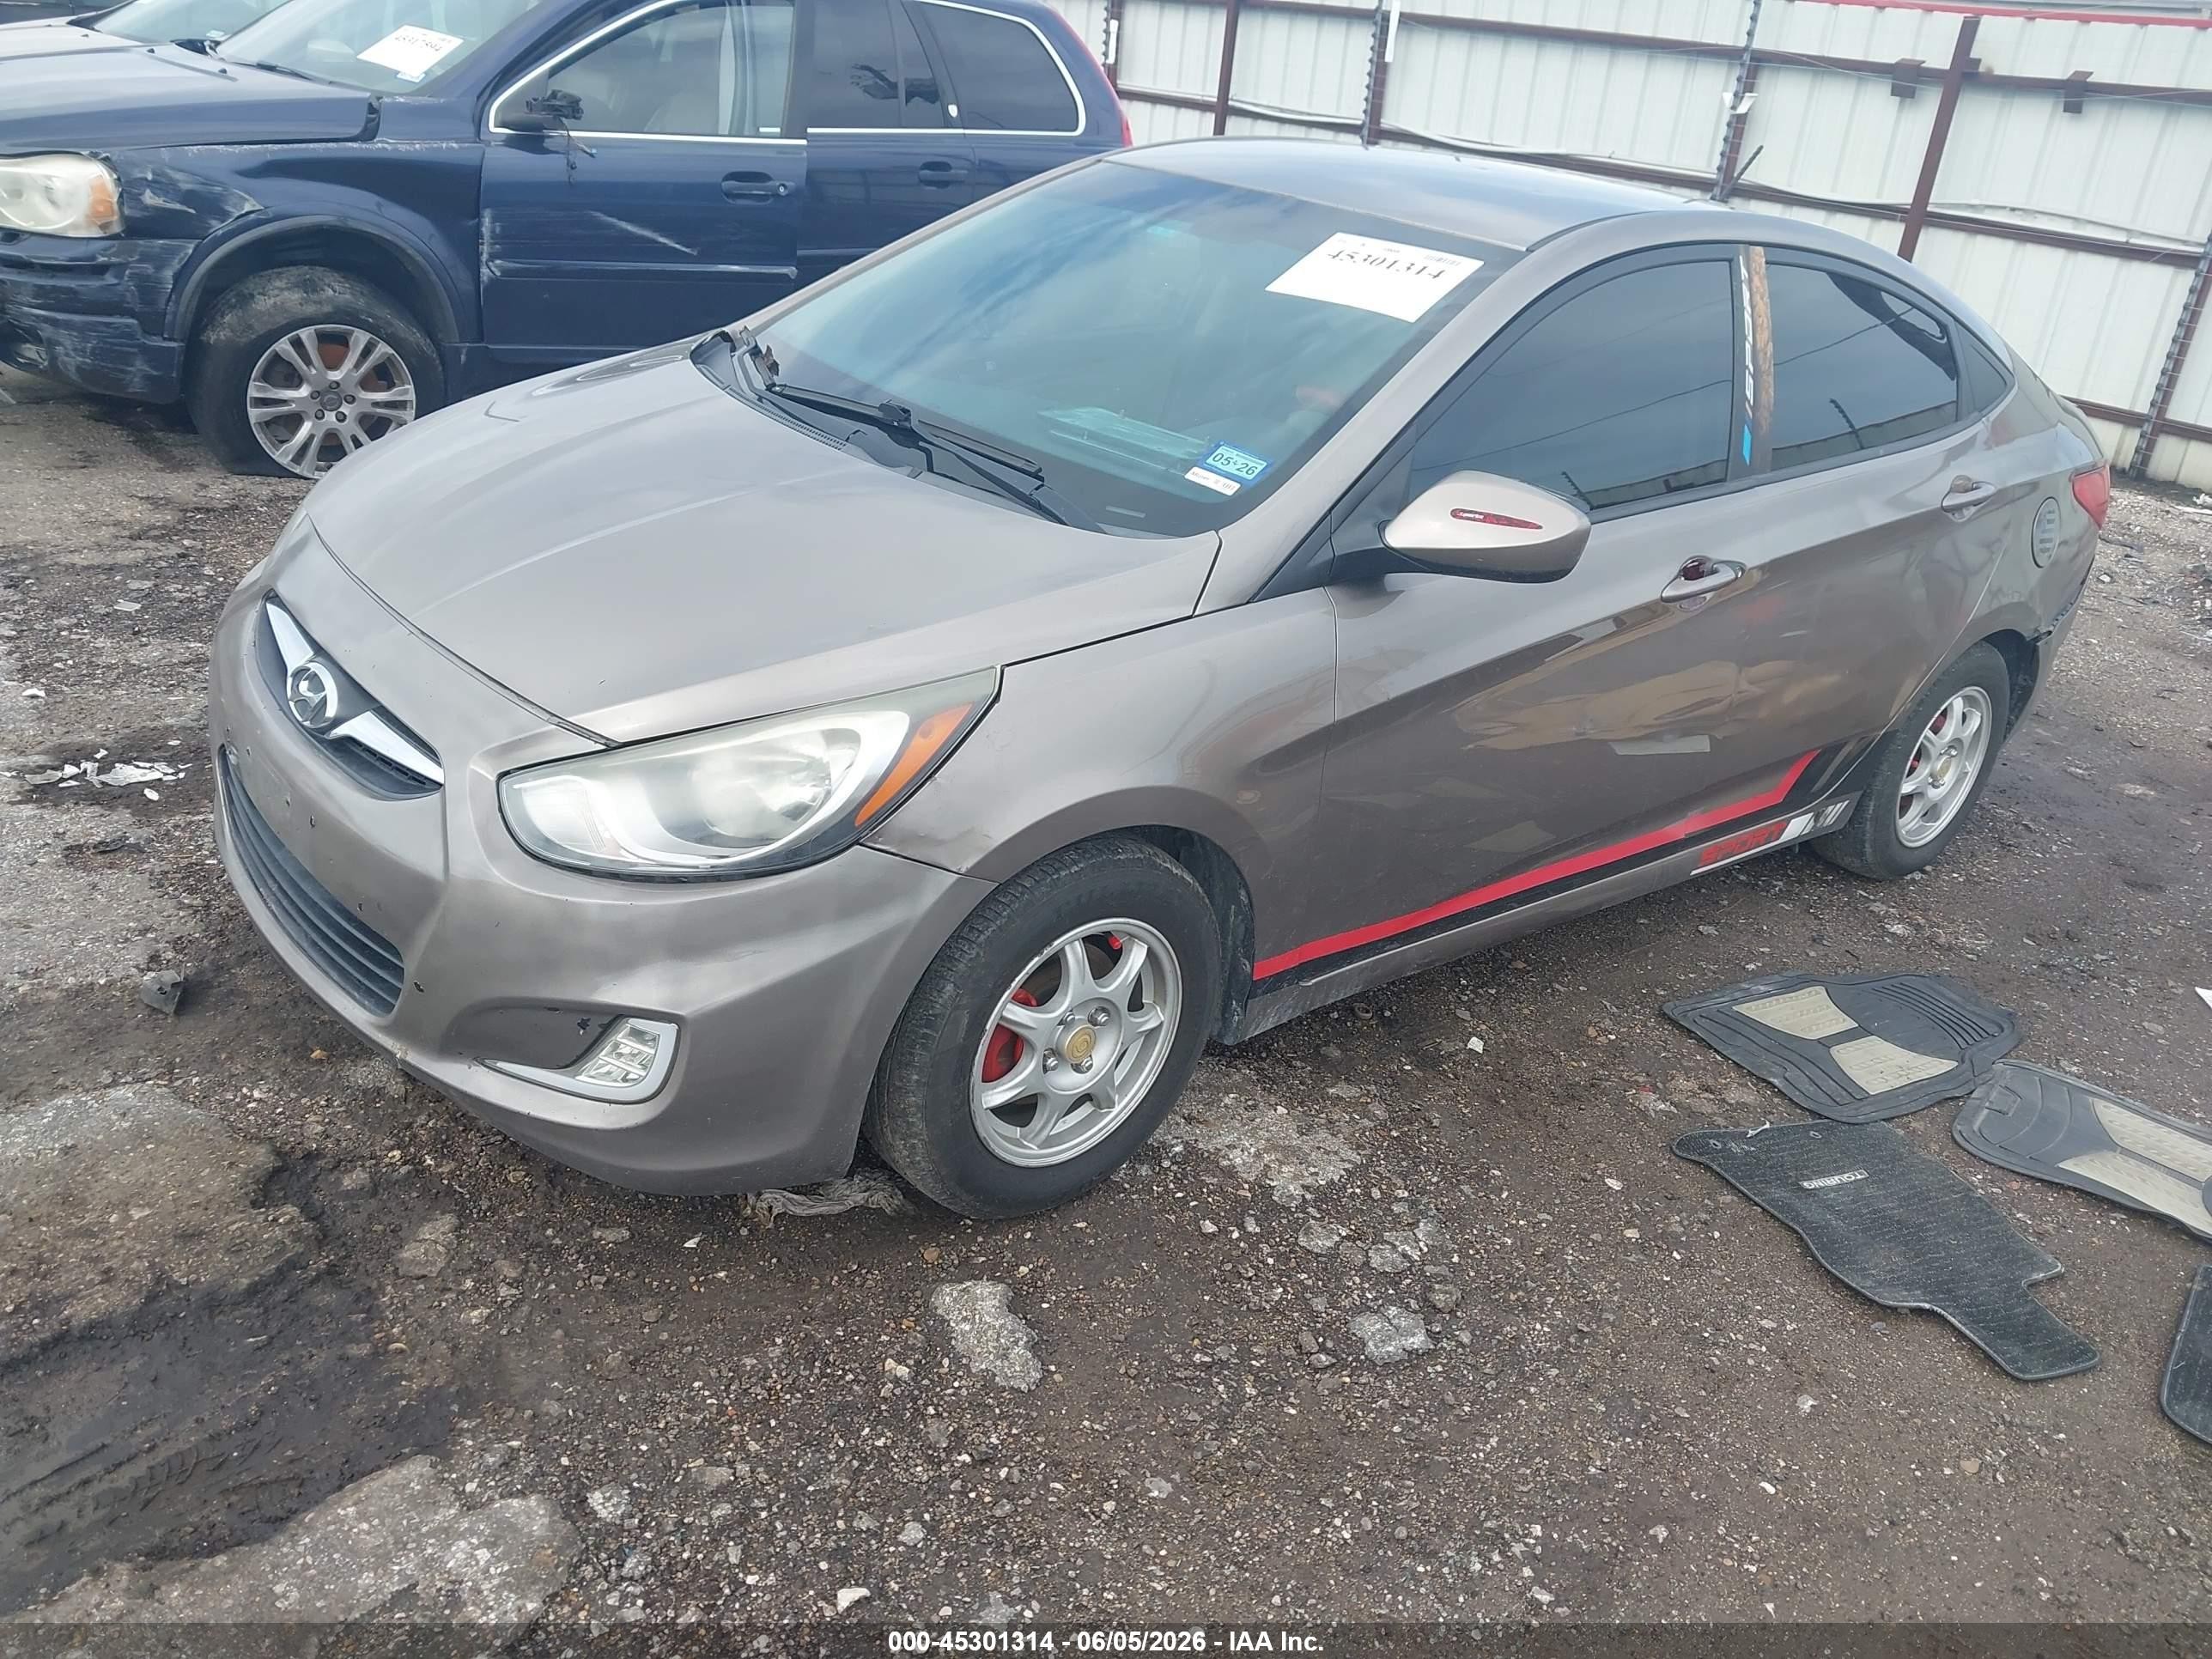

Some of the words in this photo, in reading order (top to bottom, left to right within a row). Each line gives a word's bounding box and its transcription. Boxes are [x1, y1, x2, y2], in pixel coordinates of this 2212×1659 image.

[1327, 249, 1446, 279] 45301314
[1739, 254, 1753, 405] SPORT
[1212, 452, 1234, 467] 05
[1235, 462, 1258, 477] 26
[1699, 820, 1788, 866] SPORT
[1802, 1170, 1864, 1189] TOURING
